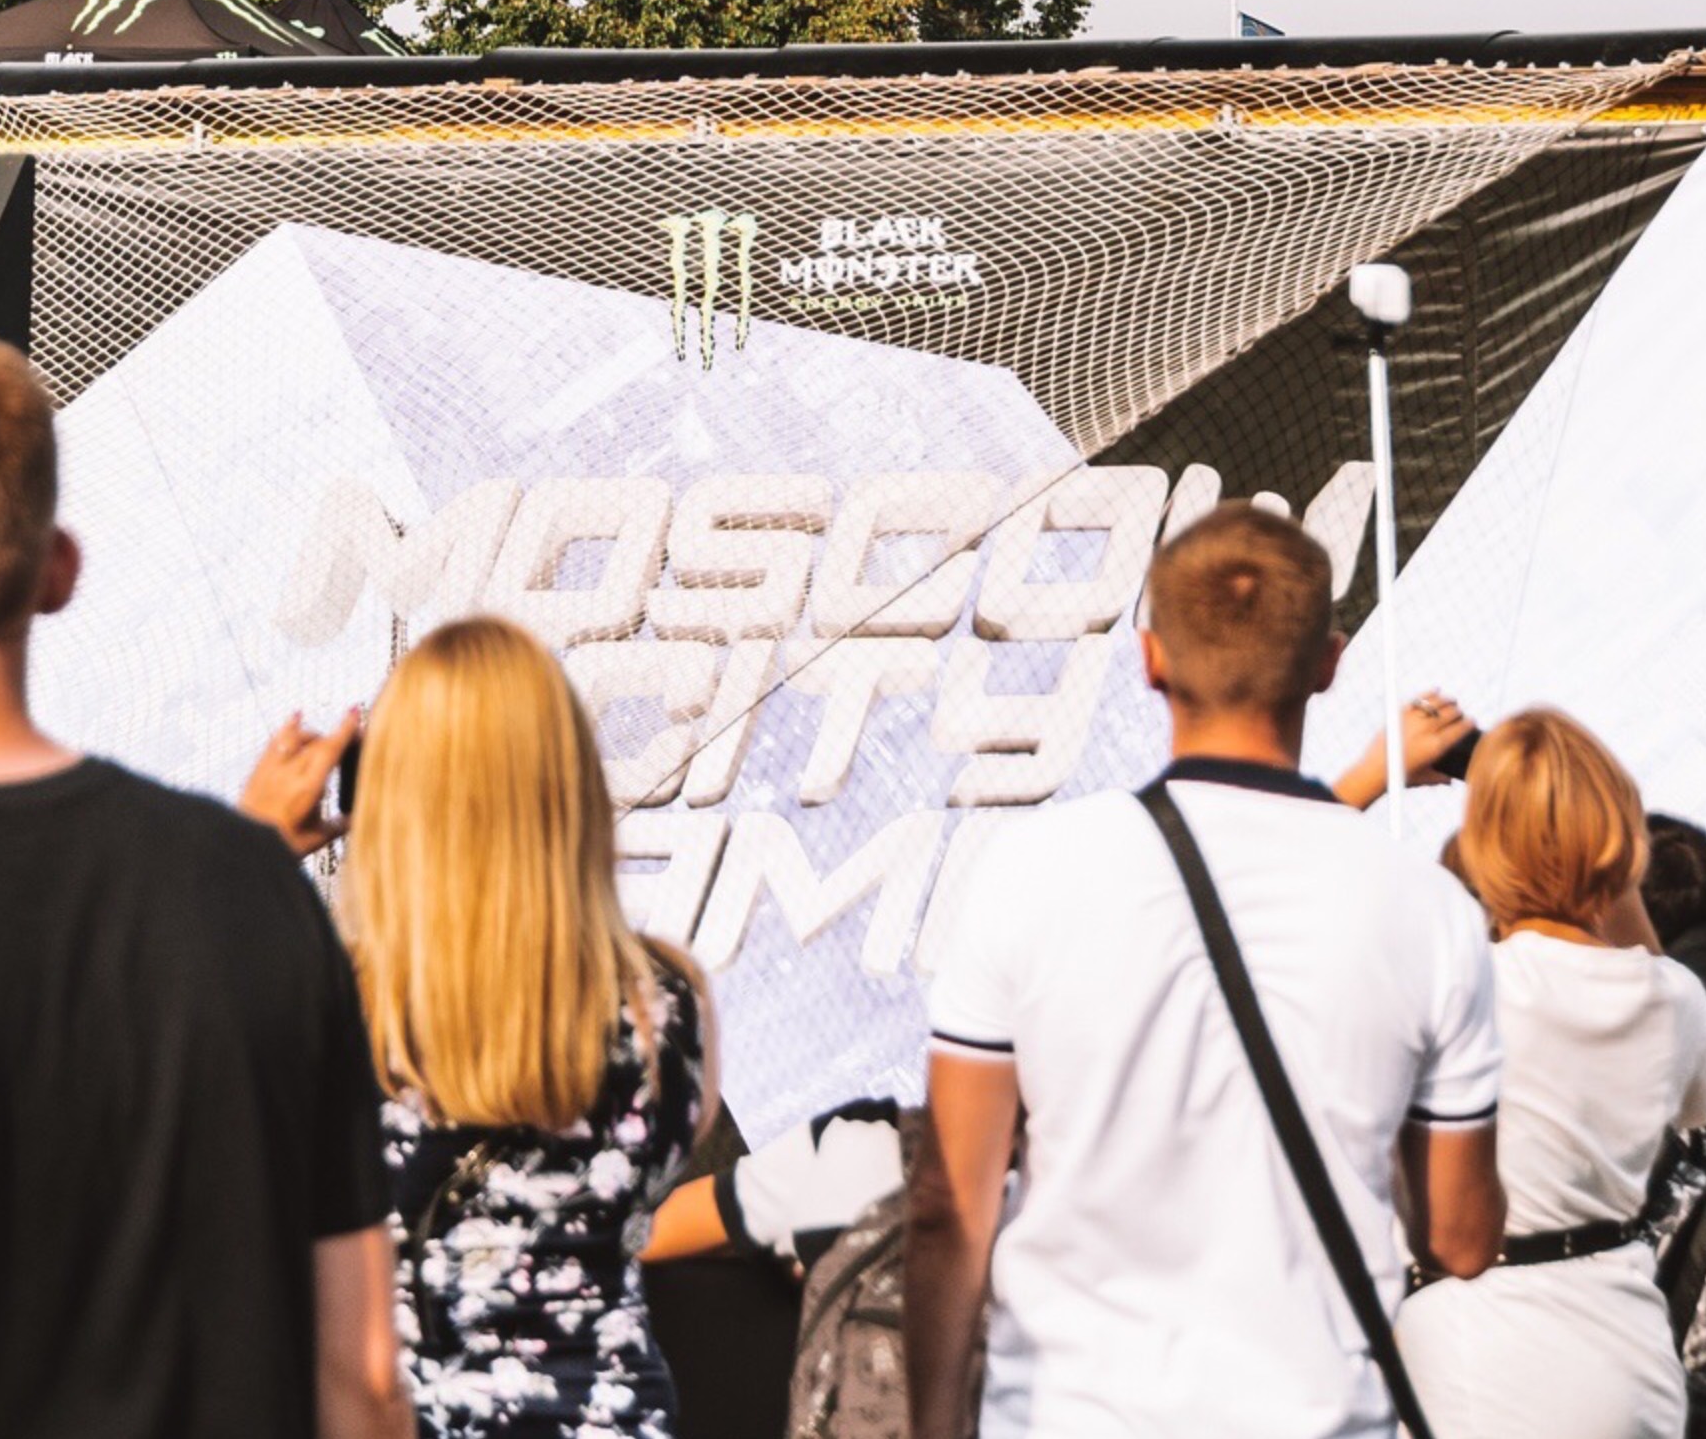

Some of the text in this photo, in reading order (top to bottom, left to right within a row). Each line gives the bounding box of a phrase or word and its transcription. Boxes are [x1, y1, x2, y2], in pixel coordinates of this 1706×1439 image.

[820, 216, 946, 250] BLACK
[780, 250, 982, 292] MONSTER
[564, 630, 1111, 809] CITY
